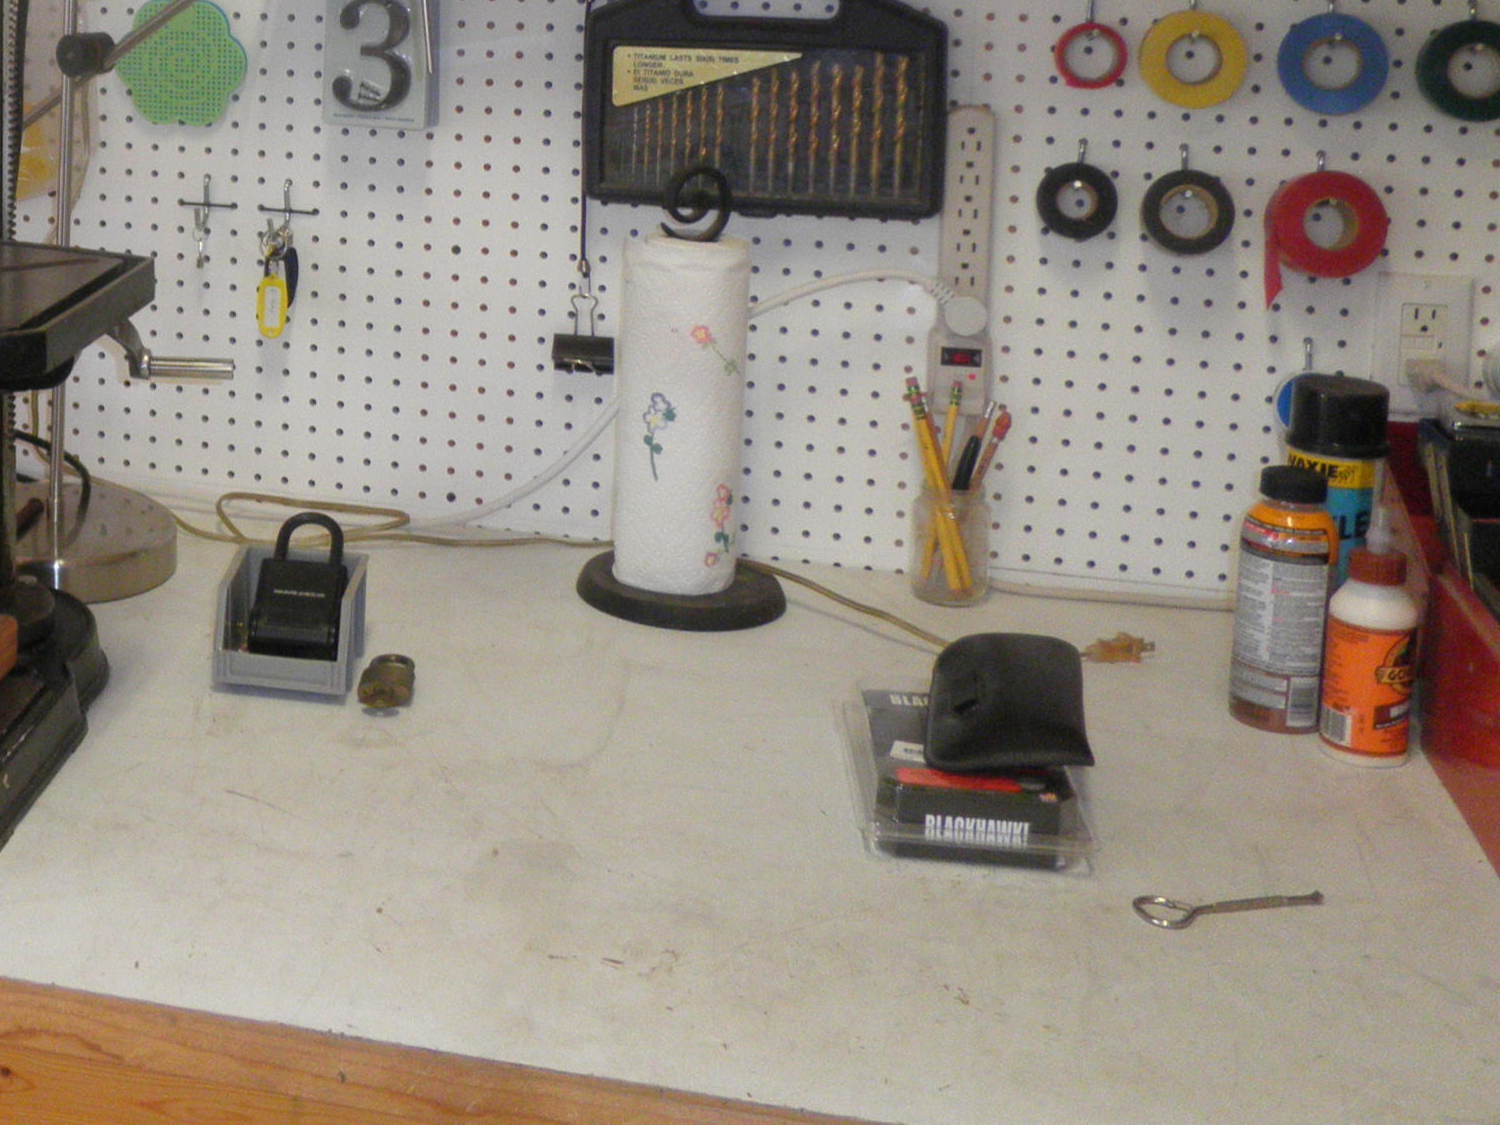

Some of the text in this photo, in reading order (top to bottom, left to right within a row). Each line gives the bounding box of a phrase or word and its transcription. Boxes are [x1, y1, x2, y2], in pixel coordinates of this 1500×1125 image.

[633, 53, 667, 61] TITANIUM
[669, 54, 693, 62] LASTS
[718, 56, 741, 64] TIMES
[633, 61, 664, 70] LONGER
